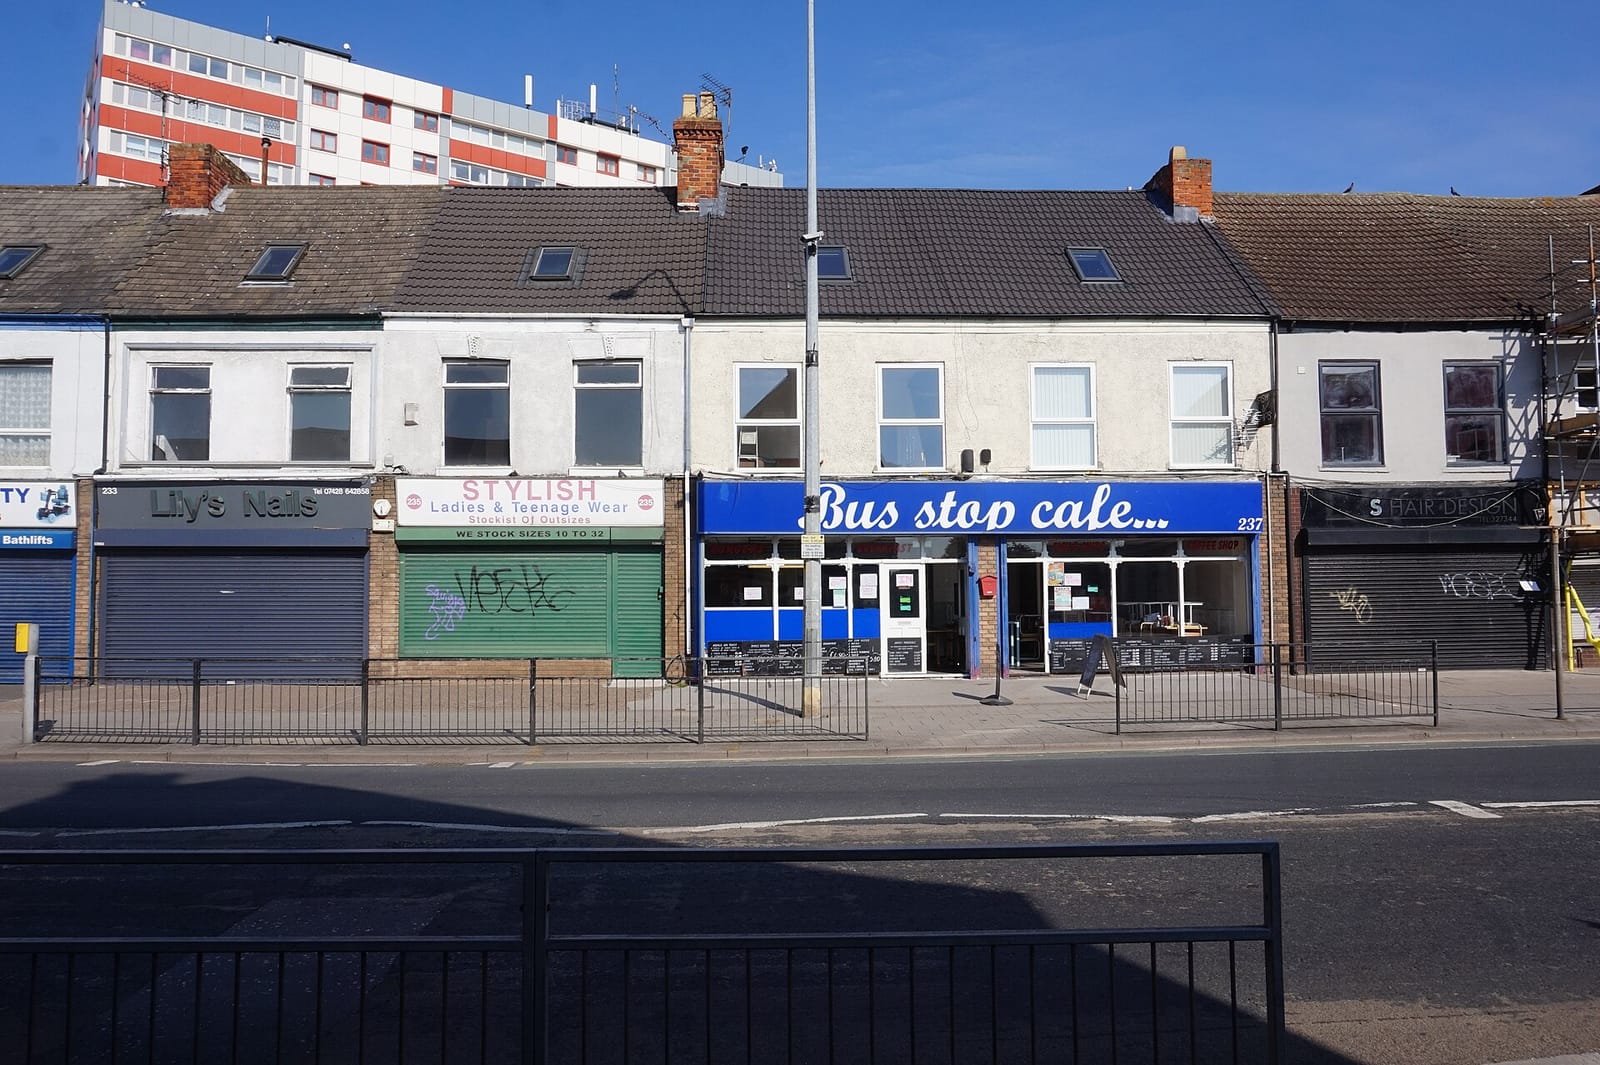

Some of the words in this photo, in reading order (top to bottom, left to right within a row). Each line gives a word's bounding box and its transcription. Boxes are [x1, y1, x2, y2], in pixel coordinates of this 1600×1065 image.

[102, 487, 117, 495] 233
[463, 480, 596, 501] STYLISH
[151, 490, 226, 523] Lily's
[243, 490, 320, 518] Nails
[406, 497, 422, 506] 235
[430, 501, 485, 513] Ladies
[494, 501, 503, 513] &
[512, 501, 579, 516] Teenage
[588, 501, 628, 513] Wear
[797, 483, 899, 530] Bus
[914, 490, 1016, 531] stop
[1390, 498, 1434, 515] HAIR
[1443, 498, 1517, 515] DESIGN
[468, 515, 516, 524] Stockist
[540, 515, 591, 524] Outsizes
[1237, 517, 1263, 531] 237
[2, 535, 53, 545] Bathlifts
